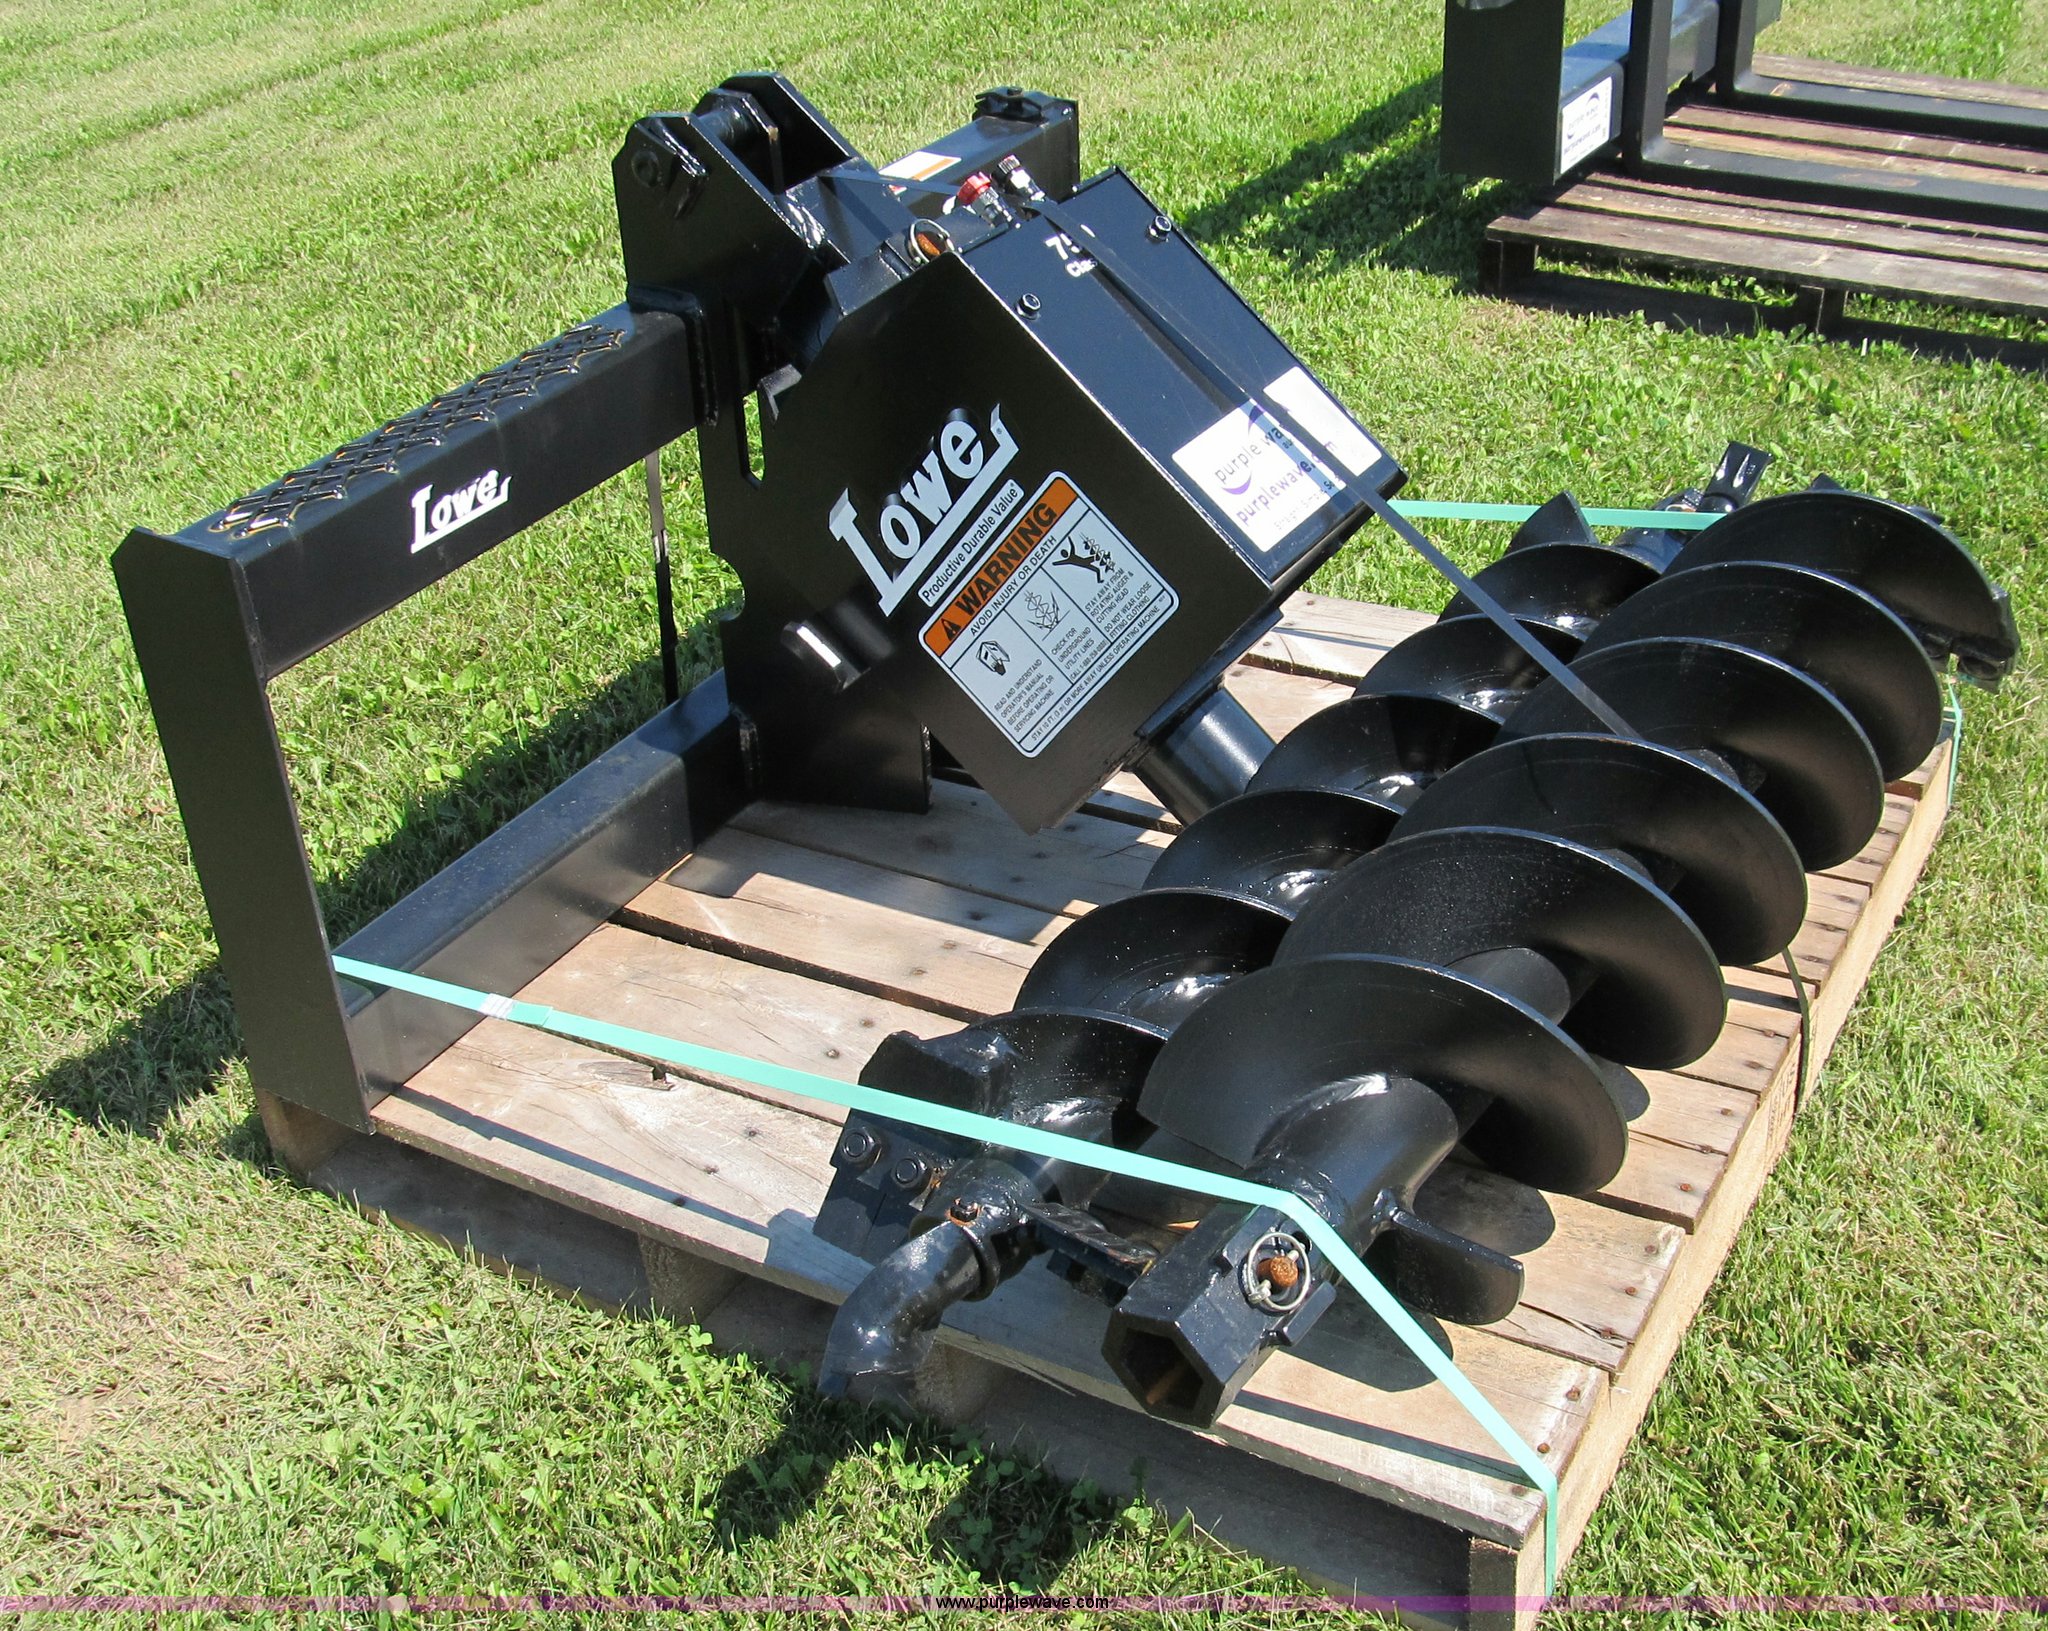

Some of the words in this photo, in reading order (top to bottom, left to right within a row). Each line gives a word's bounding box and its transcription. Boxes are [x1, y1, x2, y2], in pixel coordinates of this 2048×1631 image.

[1215, 441, 1262, 484] purple
[410, 469, 512, 554] Lowe
[829, 403, 1019, 616] Lowe
[921, 549, 966, 603] Productive
[960, 512, 997, 555] Durable
[955, 502, 1057, 616] WARNING
[968, 608, 994, 637] AVOID
[990, 578, 1020, 611] INJURY
[1016, 562, 1033, 581] OR
[1029, 534, 1057, 567] DEATH
[1084, 595, 1099, 611] STAY
[1095, 581, 1112, 599] AWAY
[1109, 567, 1125, 584] FROM
[1090, 591, 1114, 618] ROTATING
[1111, 574, 1130, 594] AUGER
[1095, 600, 1117, 623] CUTTING
[1114, 587, 1129, 603] HEAD
[1110, 611, 1123, 625] NOT
[1120, 597, 1137, 614] WEAR
[1133, 580, 1152, 600] LOOSE
[1109, 618, 1128, 639] FITTING
[1125, 594, 1150, 621] CLOTHING
[1050, 637, 1067, 656] CHECK
[1065, 626, 1077, 640] FOR
[1057, 625, 1091, 663] UNDERGROUND
[1064, 650, 1082, 670] UTILITY
[1079, 637, 1095, 653] LINES
[993, 696, 1007, 711] READ
[1004, 686, 1016, 699] AND
[1013, 657, 1043, 690] UNDERSTAND
[1024, 670, 1044, 692] MANUAL
[1030, 727, 1044, 741] STAY
[1069, 683, 1085, 700] MORE
[1082, 669, 1098, 687] AWAY
[1095, 651, 1115, 673] UNLESS
[1111, 625, 1140, 655] OPERATING
[1136, 604, 1160, 628] MACHINE
[1006, 705, 1025, 726] BEFORE
[1022, 681, 1047, 708] OPERATING
[1013, 707, 1037, 733] SERVICING
[1033, 688, 1054, 711] MACHINE
